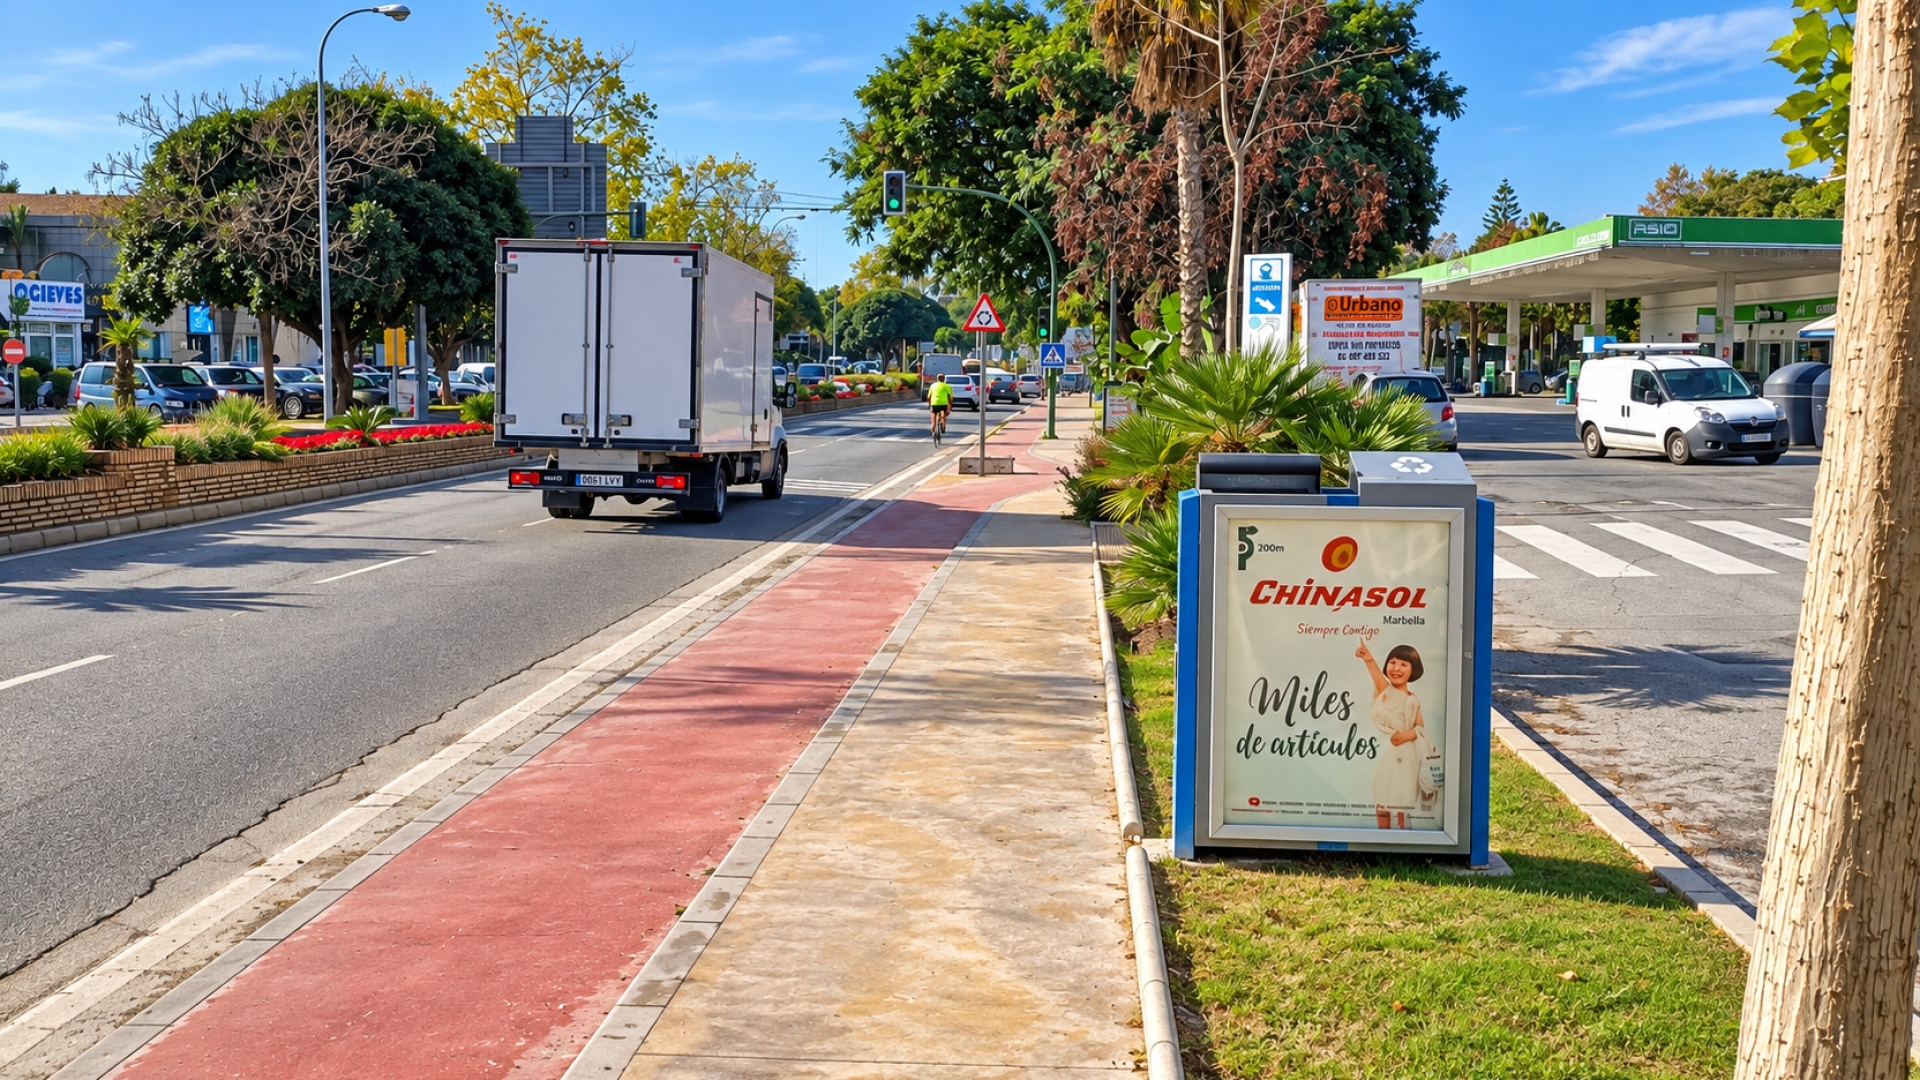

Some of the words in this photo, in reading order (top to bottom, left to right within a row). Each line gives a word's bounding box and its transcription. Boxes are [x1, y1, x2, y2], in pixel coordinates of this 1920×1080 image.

[1340, 294, 1401, 311] Urbano
[1257, 543, 1285, 553] 200m
[1382, 615, 1426, 626] Marbella
[1297, 623, 1339, 639] Siempre
[1342, 624, 1380, 641] Contigo
[1249, 670, 1355, 728] Miles
[1236, 723, 1266, 760] de
[1270, 722, 1381, 761] artículos
